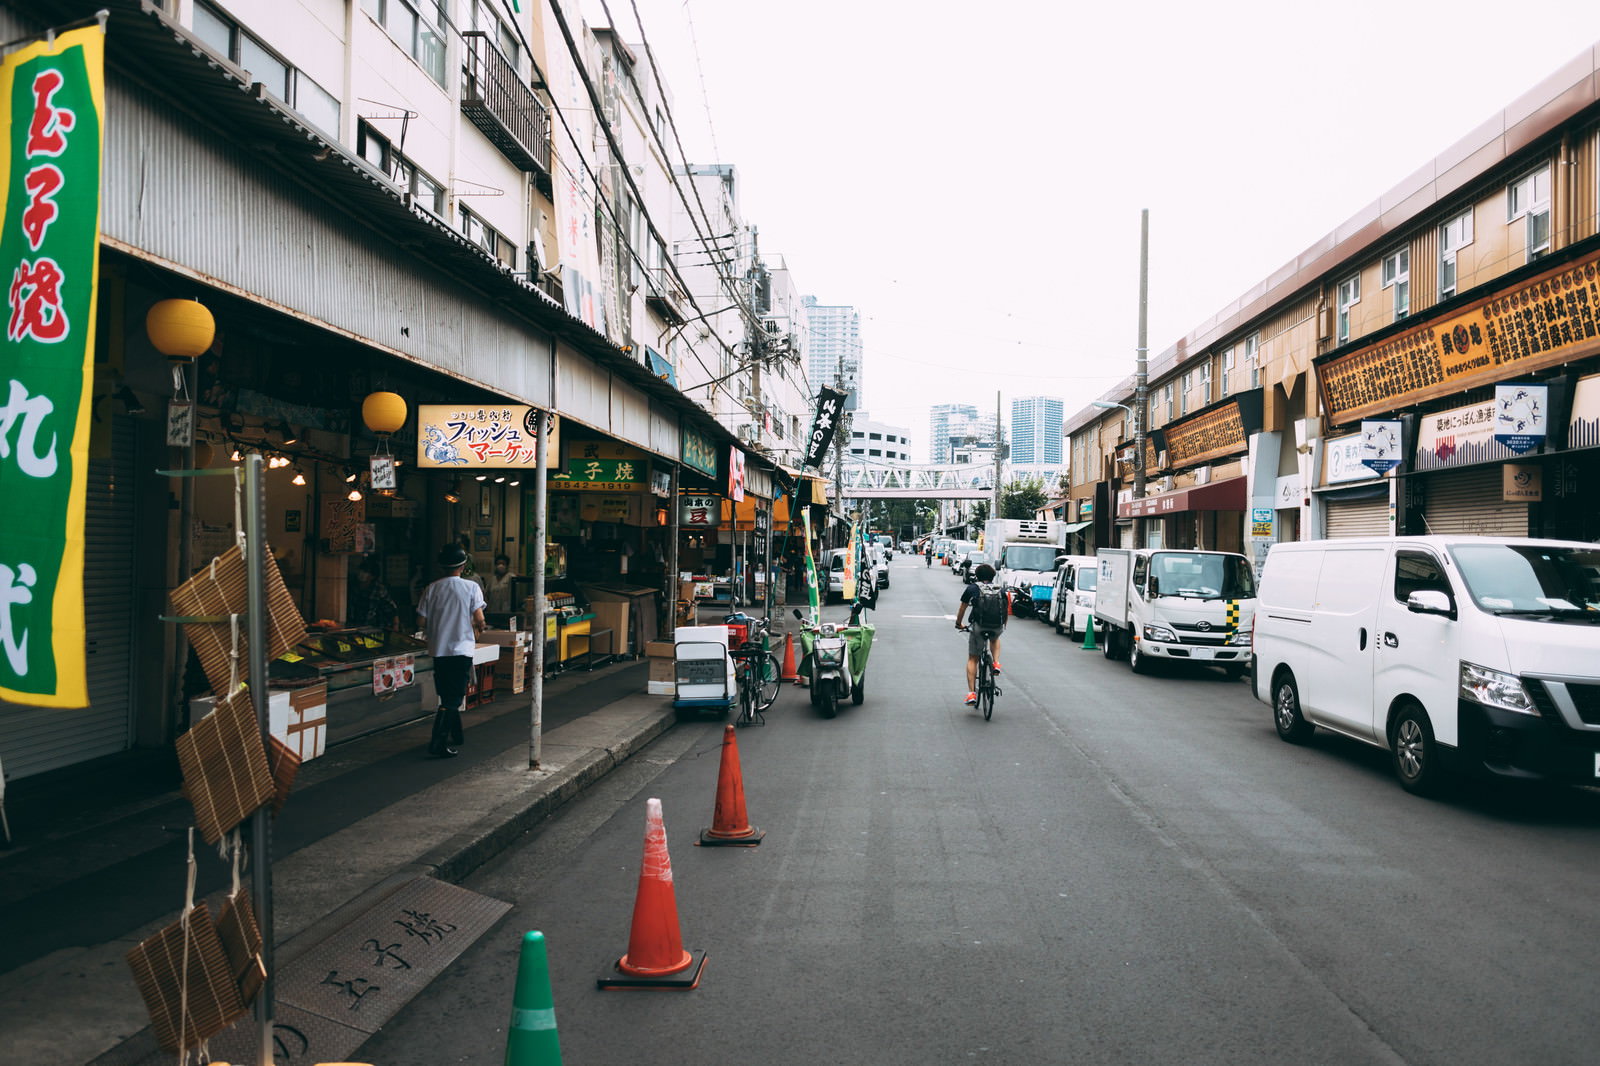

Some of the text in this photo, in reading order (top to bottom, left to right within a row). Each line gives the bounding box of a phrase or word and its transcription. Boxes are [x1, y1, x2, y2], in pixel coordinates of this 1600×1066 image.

[446, 421, 521, 442] フィッシュ
[467, 441, 537, 463] マーケッ
[1345, 444, 1361, 459] 案内
